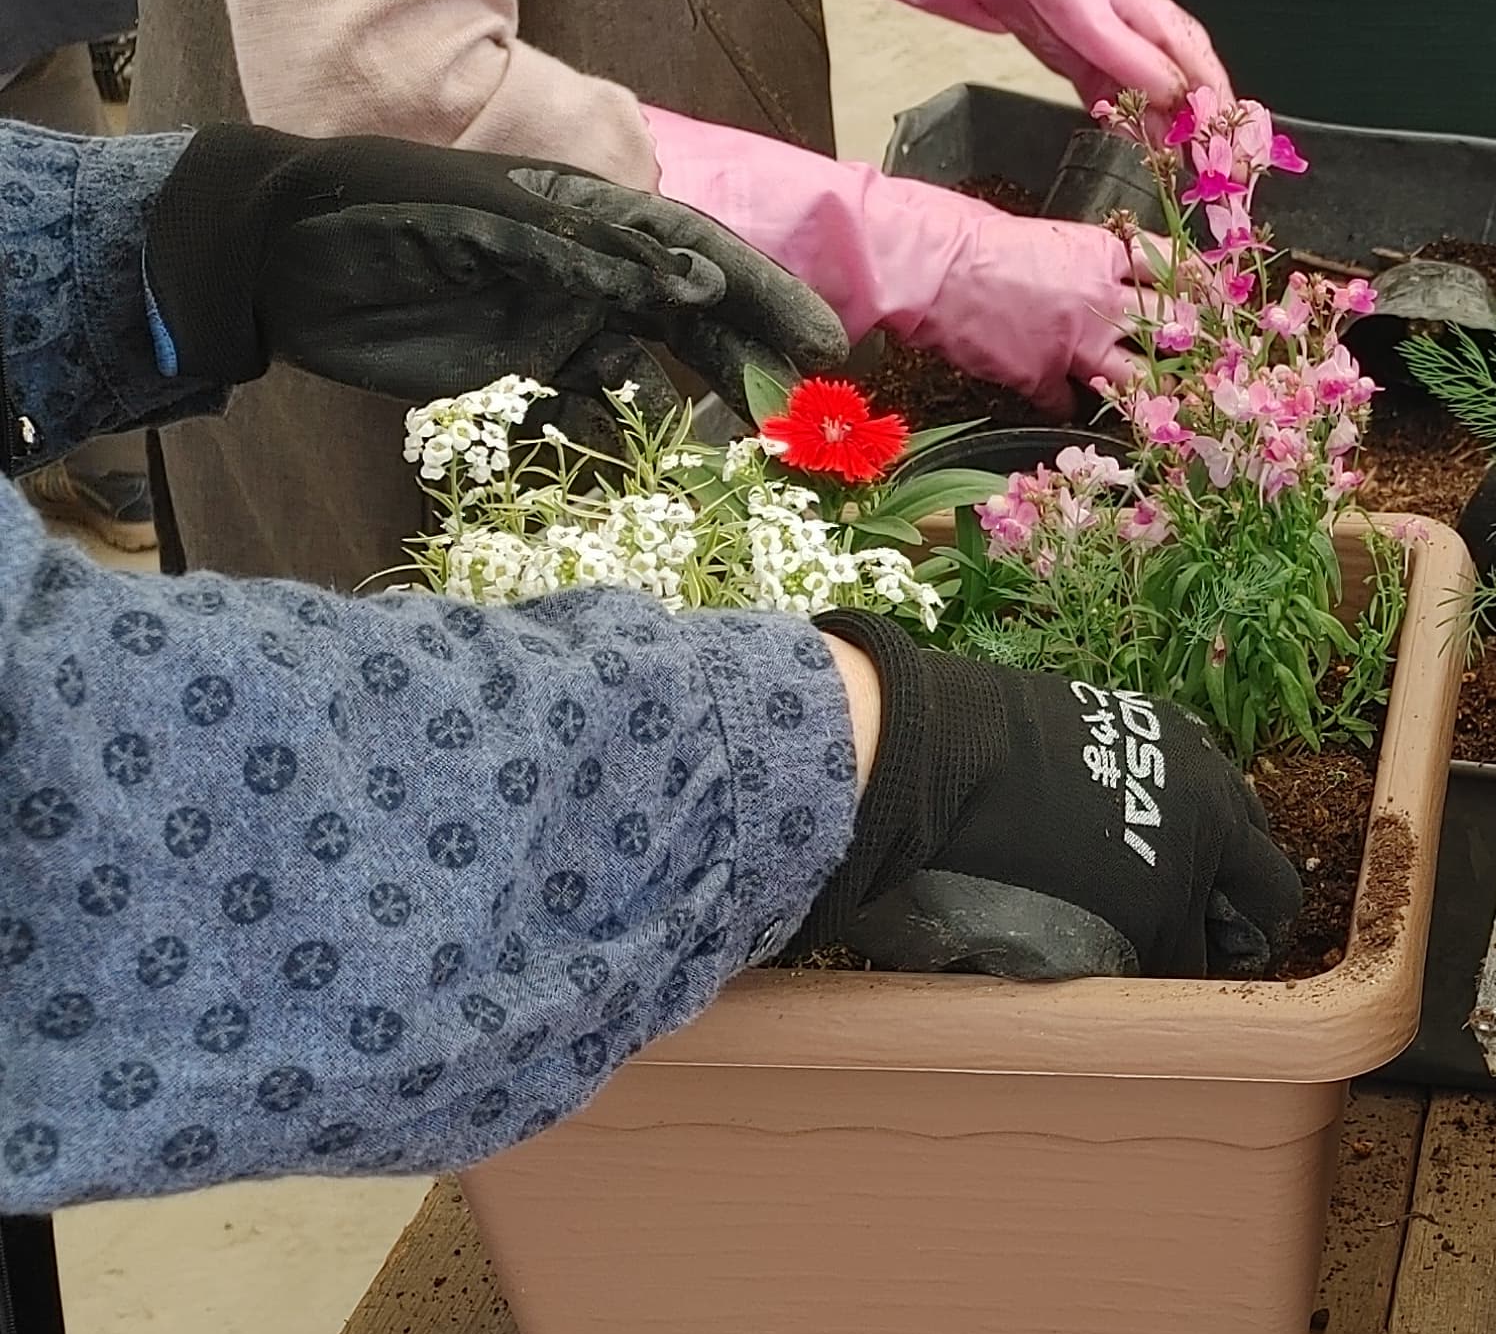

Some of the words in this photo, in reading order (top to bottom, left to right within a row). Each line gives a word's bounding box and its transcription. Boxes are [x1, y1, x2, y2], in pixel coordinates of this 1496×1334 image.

[1070, 681, 1121, 789] とやま
[1112, 689, 1166, 866] NOSAI
